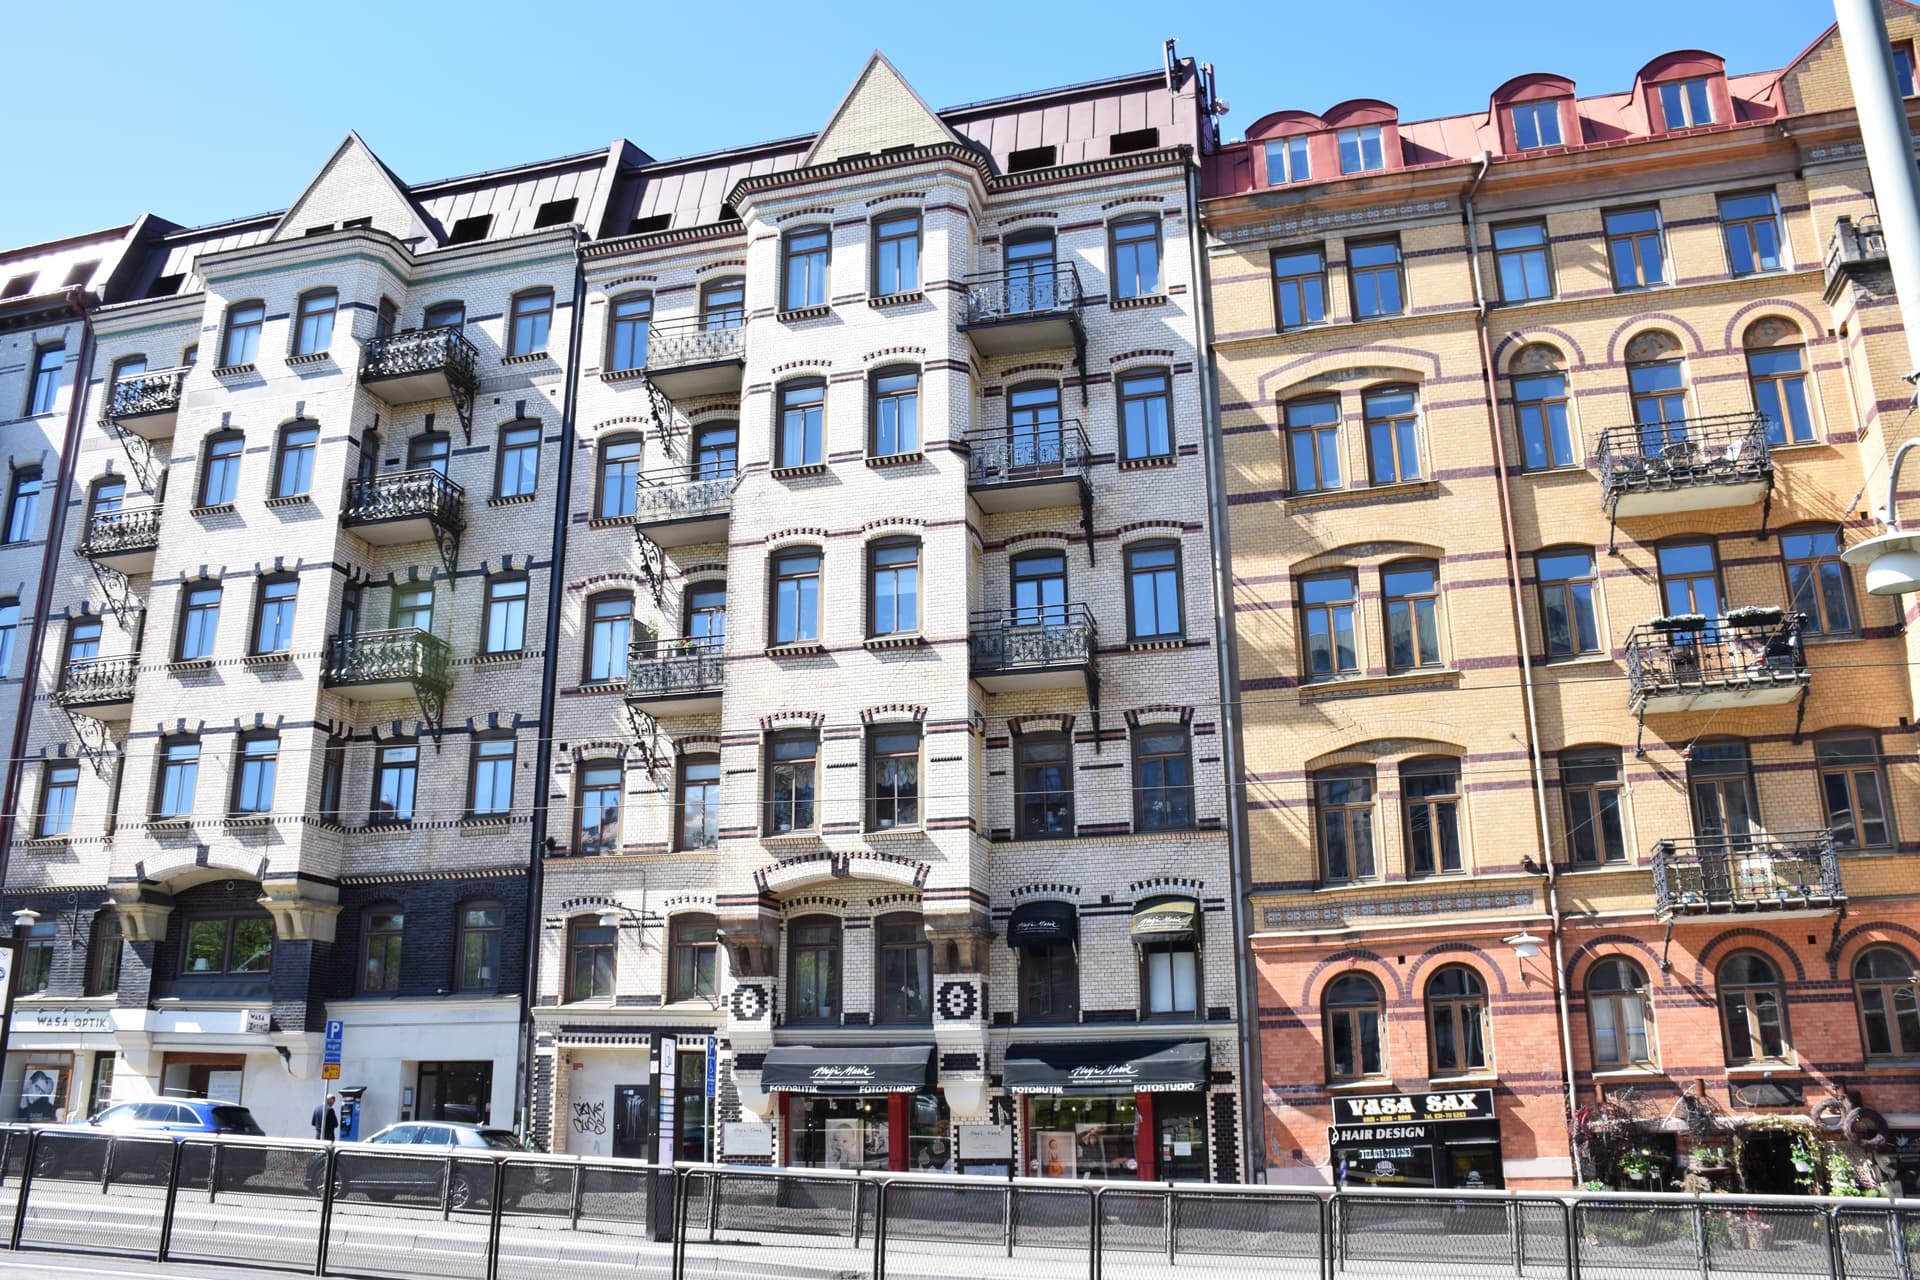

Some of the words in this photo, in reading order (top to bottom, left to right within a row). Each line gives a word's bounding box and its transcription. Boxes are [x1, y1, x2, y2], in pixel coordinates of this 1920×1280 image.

[37, 1016, 68, 1027] WASA
[74, 1017, 107, 1028] OPTIK
[769, 1085, 818, 1093] FOTOBUTIK
[859, 1085, 916, 1093] FOTOSTUDIO
[1011, 1086, 1064, 1094] FOTOBUTIK
[1133, 1082, 1195, 1093] FOTOSTUDIO
[1347, 1097, 1416, 1116] VASA
[1425, 1093, 1478, 1112] SAX
[1341, 1129, 1373, 1141] HAIR
[1375, 1126, 1425, 1140] DESIGN
